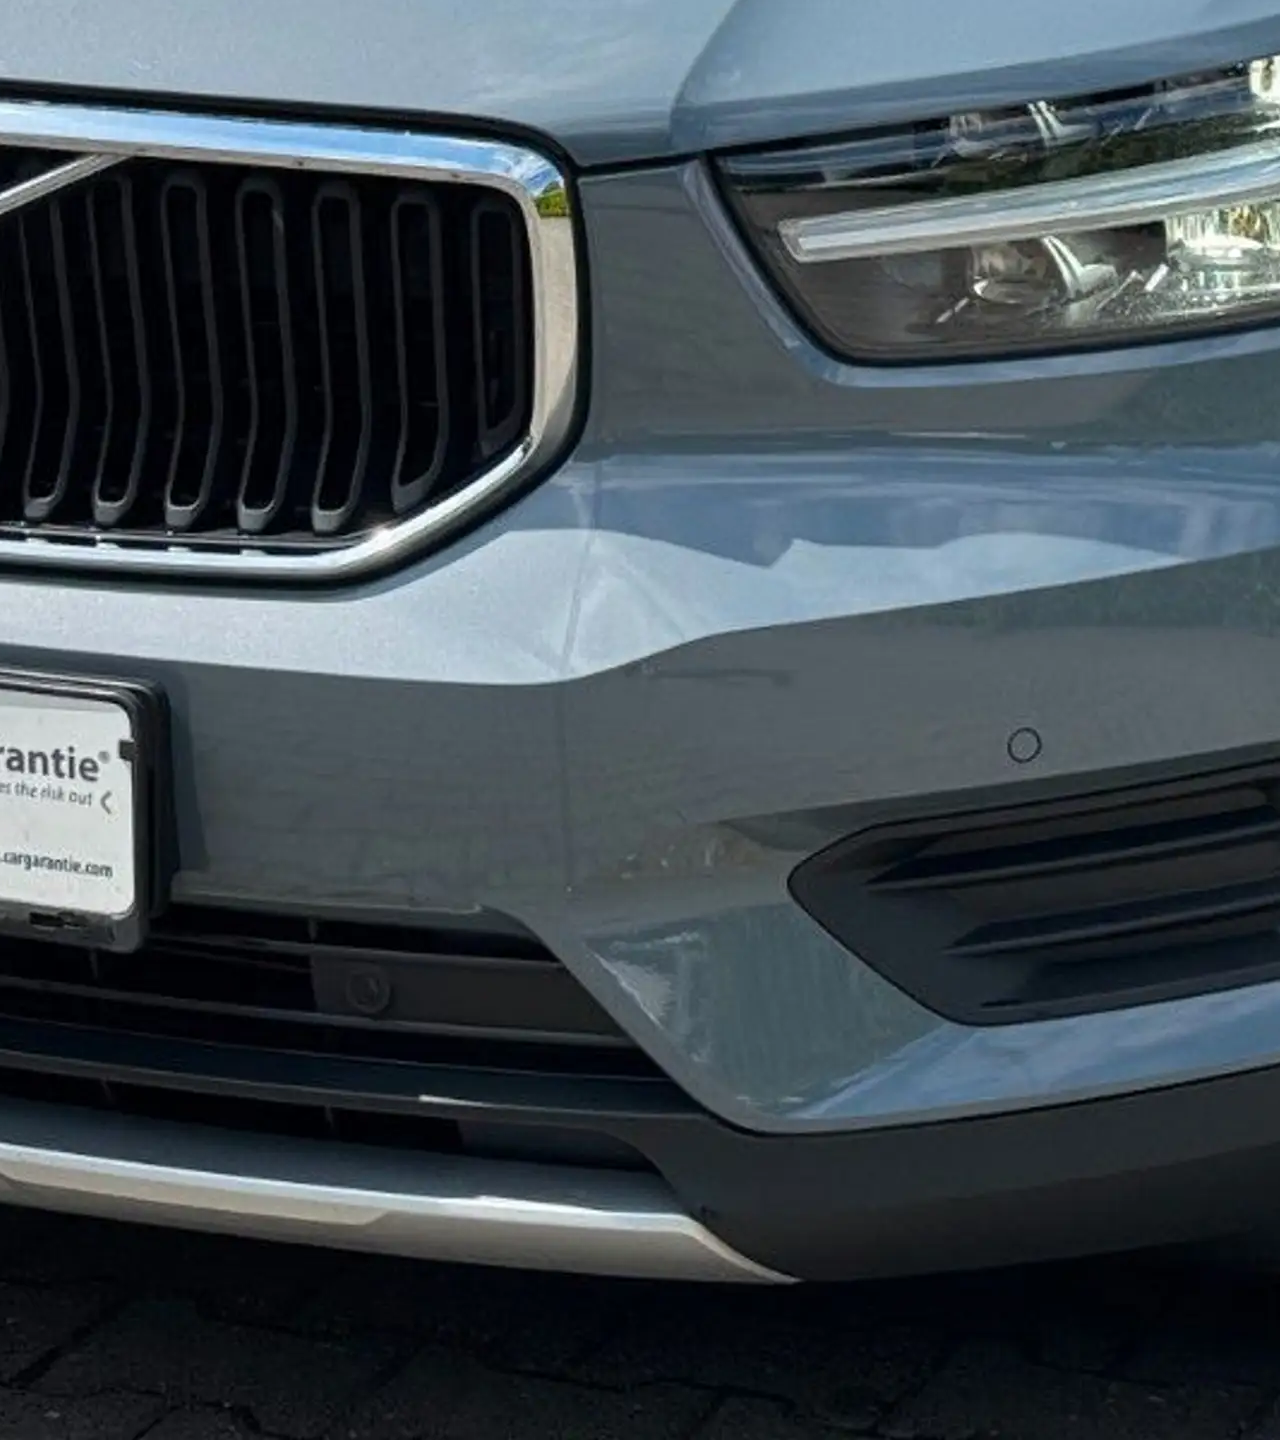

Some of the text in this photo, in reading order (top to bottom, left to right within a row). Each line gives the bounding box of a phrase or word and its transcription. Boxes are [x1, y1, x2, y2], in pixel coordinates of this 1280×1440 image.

[14, 781, 36, 799] the
[40, 784, 65, 802] risk
[69, 791, 93, 807] out
